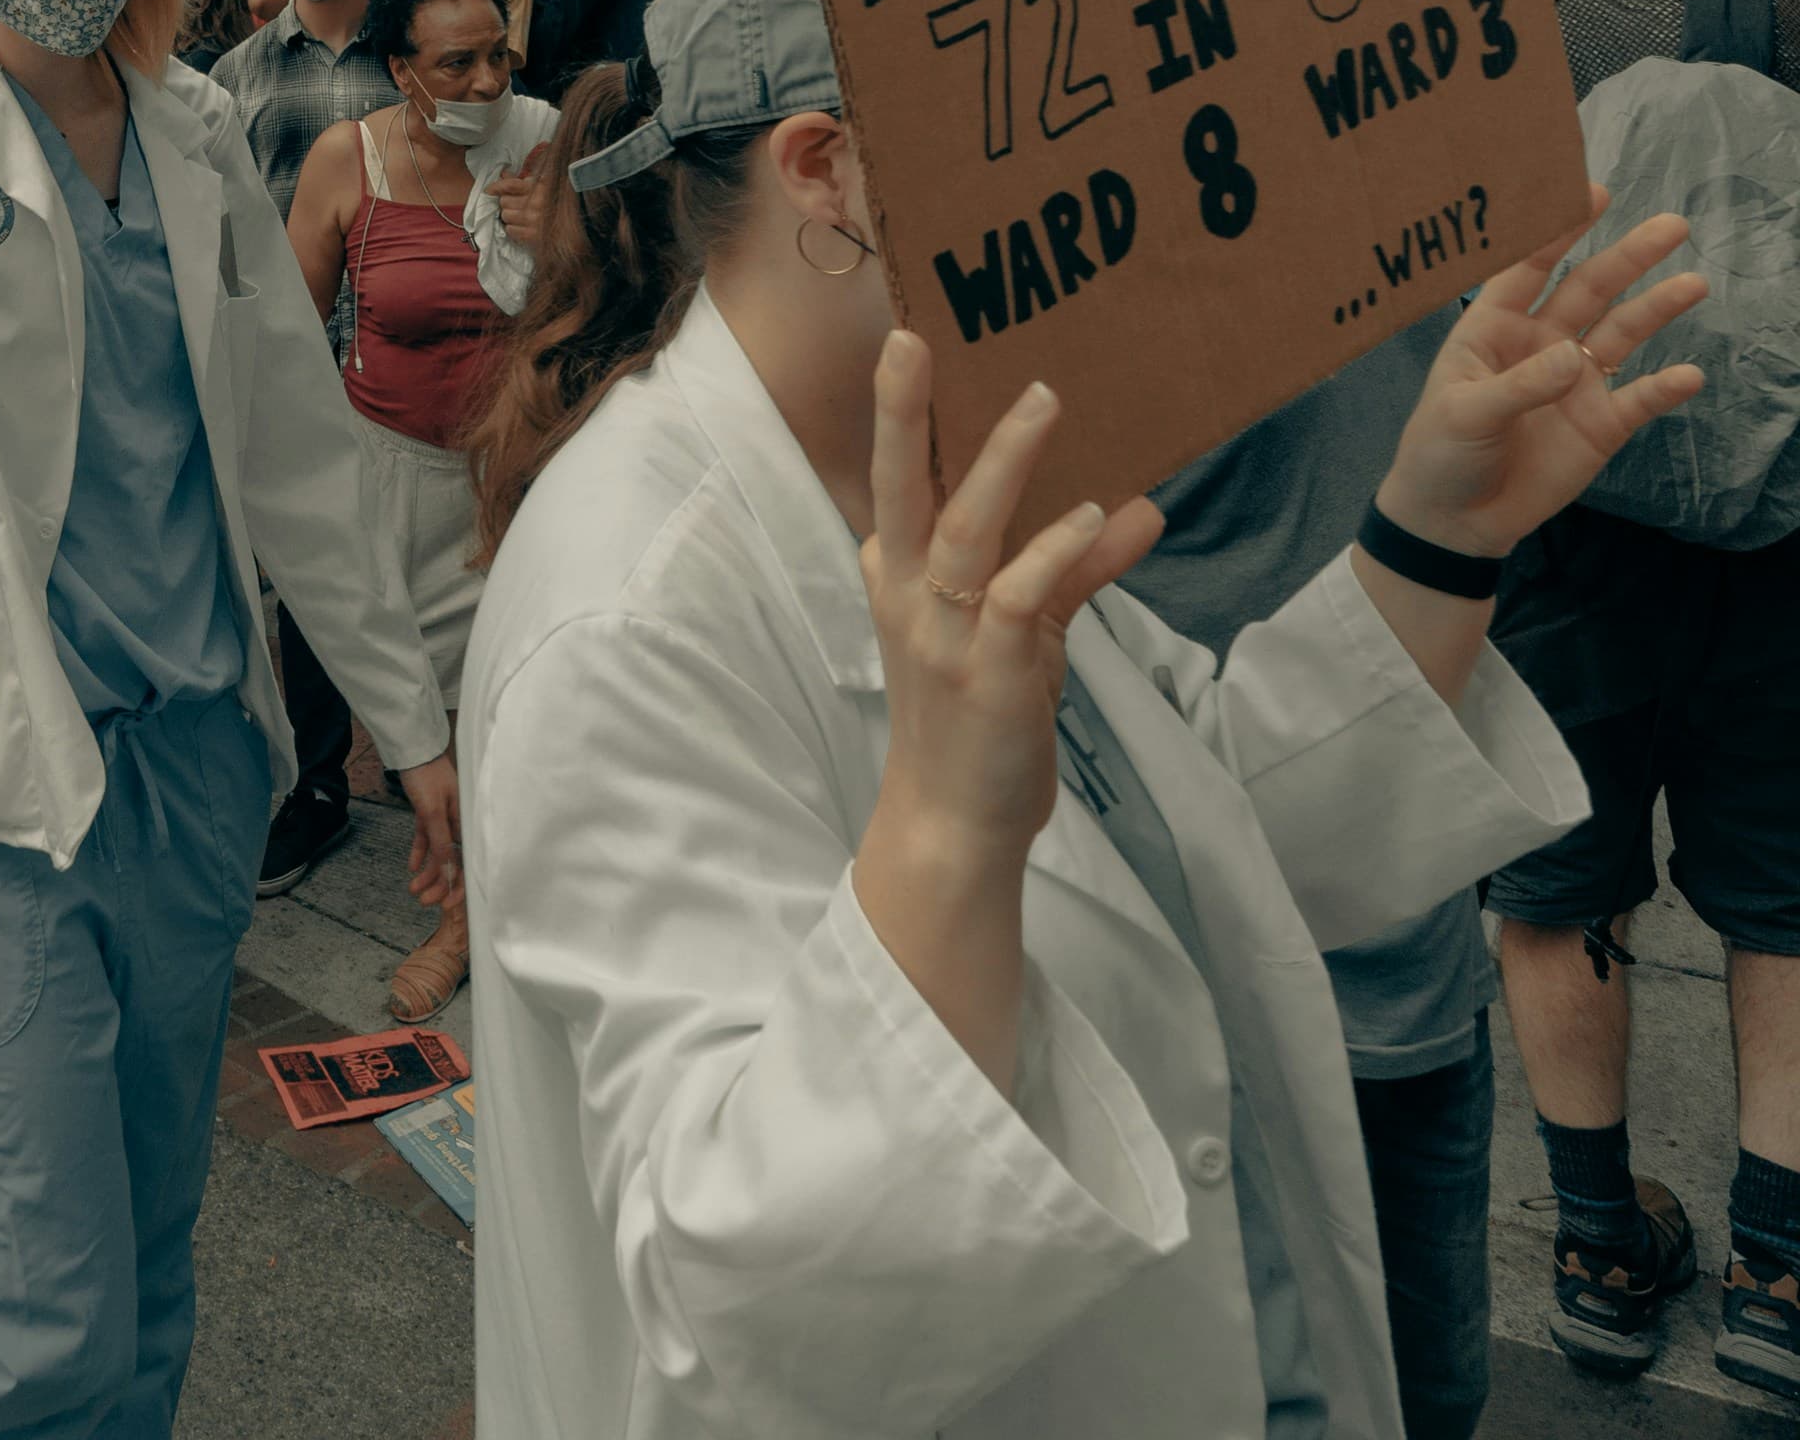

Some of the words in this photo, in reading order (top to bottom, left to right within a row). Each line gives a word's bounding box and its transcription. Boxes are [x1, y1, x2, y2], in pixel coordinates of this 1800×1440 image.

[1303, 6, 1459, 139] WARD
[932, 169, 1137, 344] WARD
[1183, 104, 1258, 240] 8
[363, 1049, 400, 1081] KIDS
